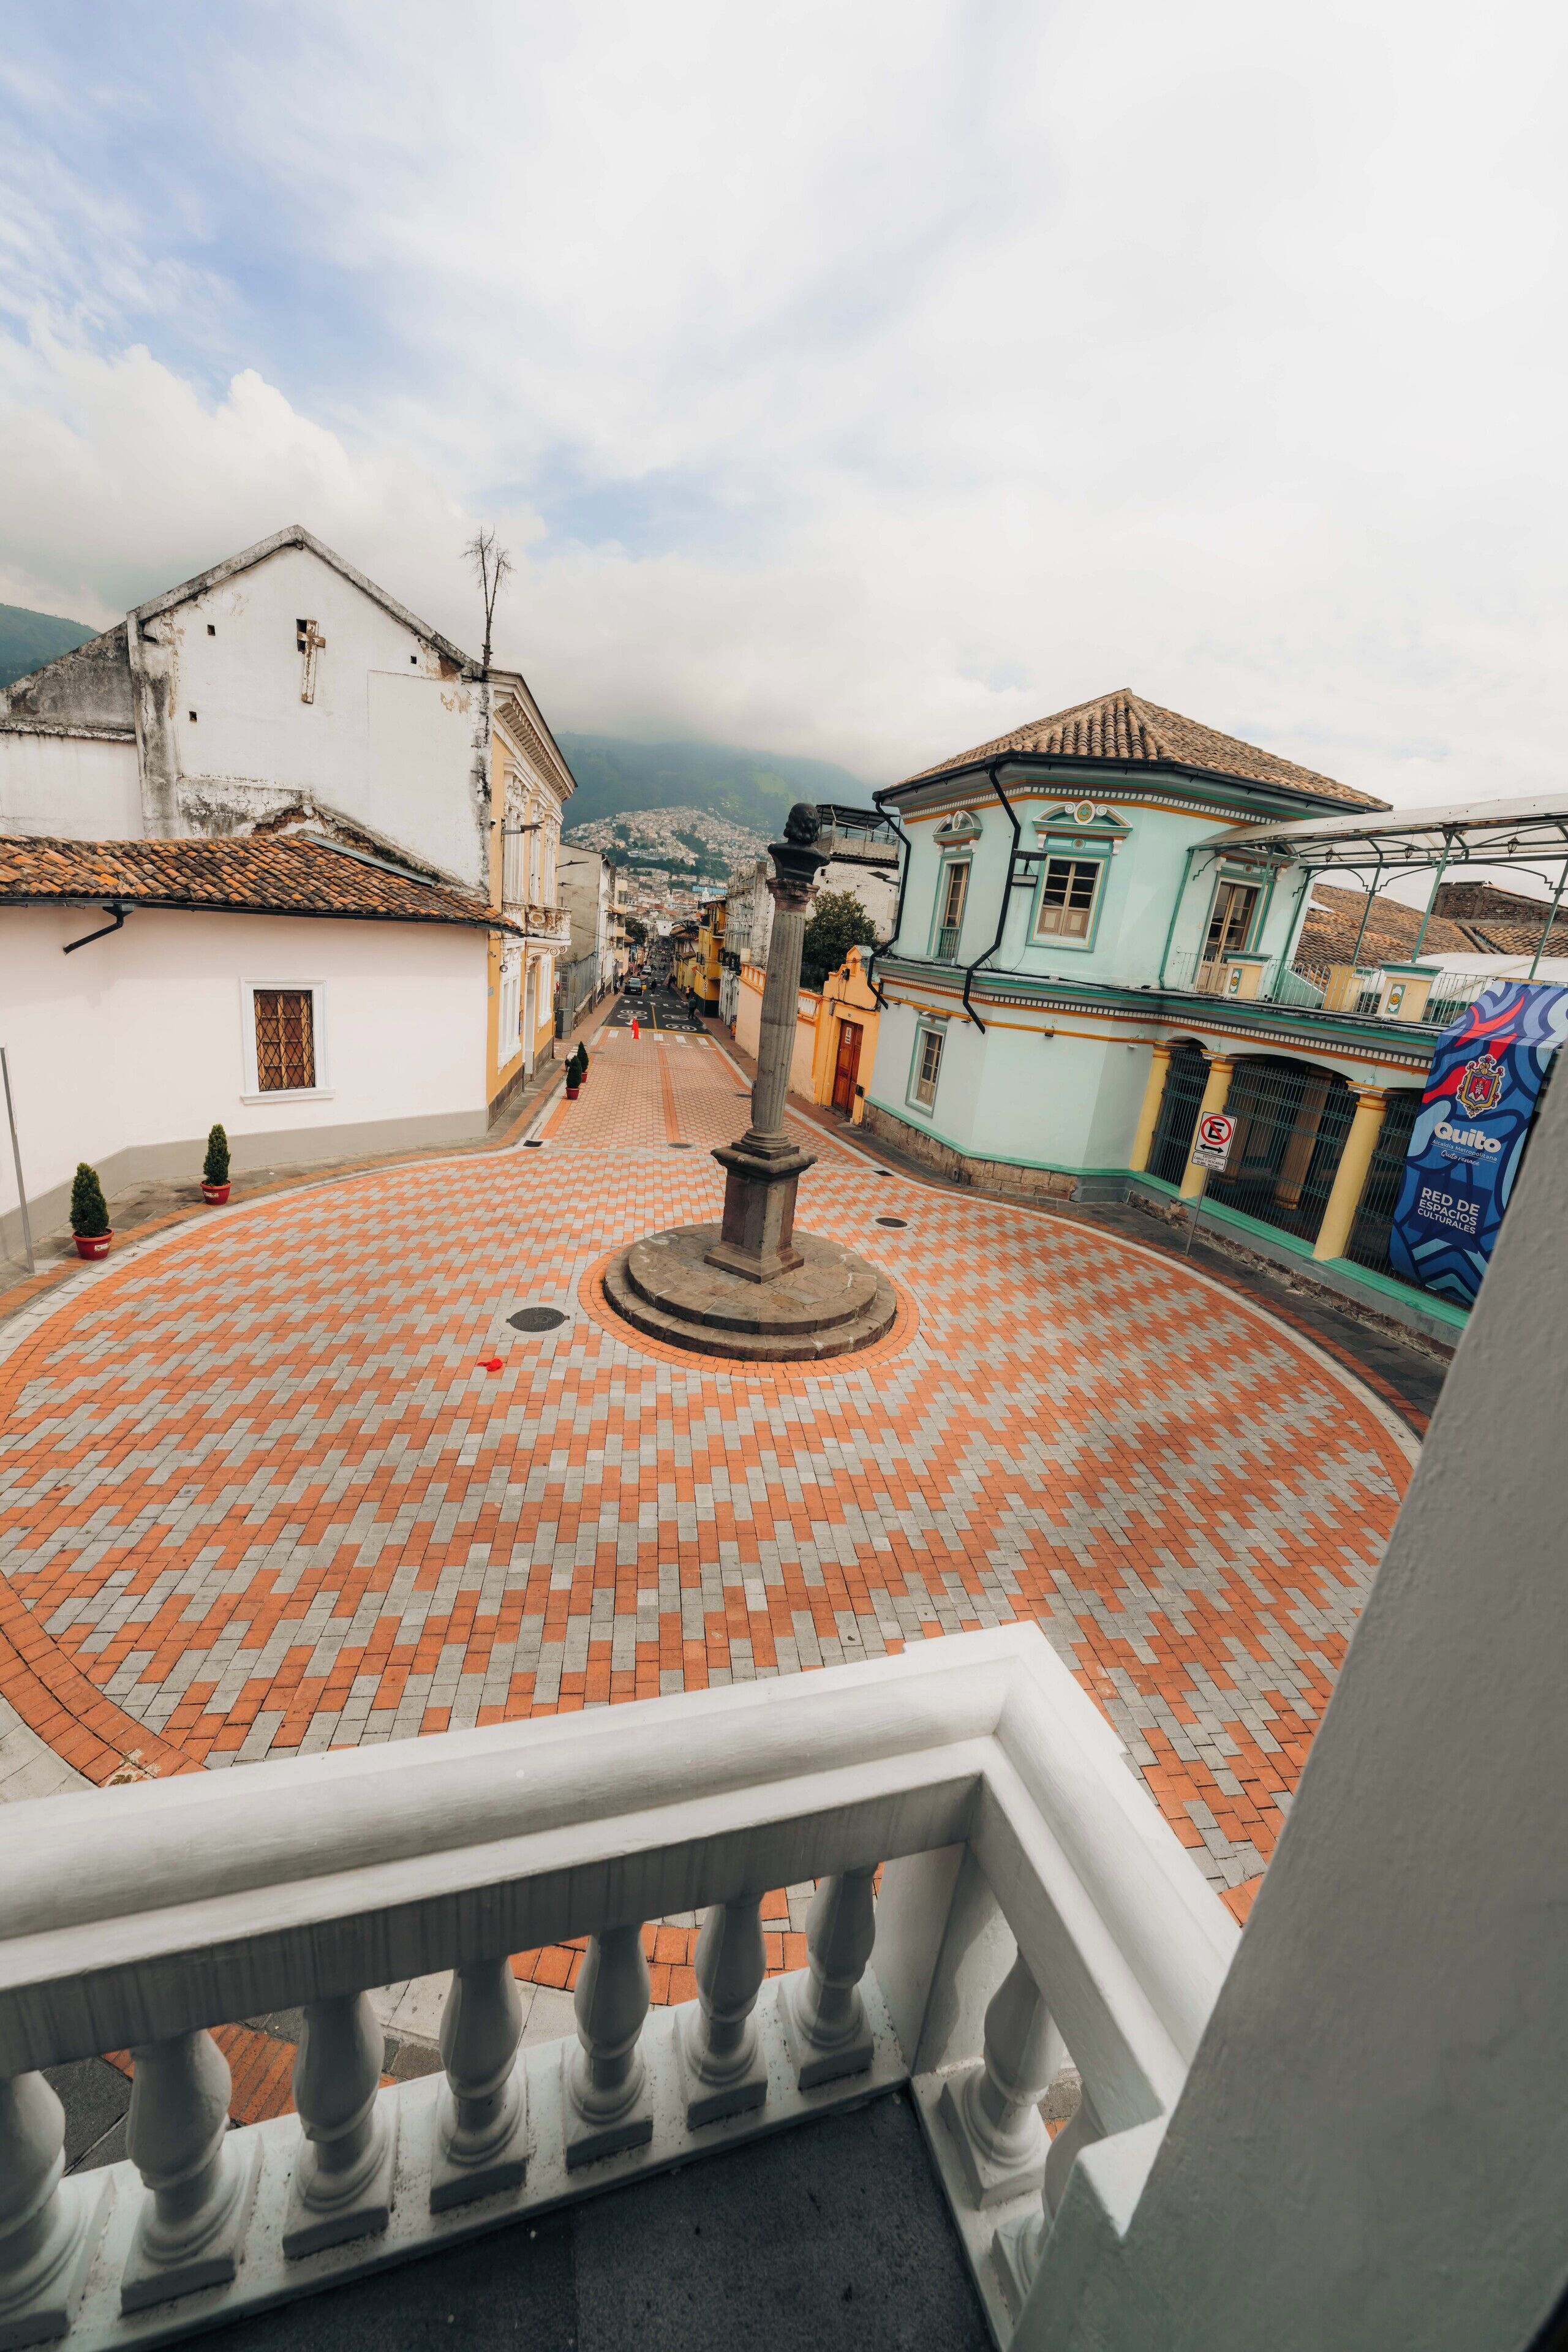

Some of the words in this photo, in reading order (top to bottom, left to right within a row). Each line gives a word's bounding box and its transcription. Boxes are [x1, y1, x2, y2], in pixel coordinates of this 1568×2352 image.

[1208, 1121, 1225, 1140] E
[1434, 1121, 1501, 1153] Quito
[1432, 1139, 1453, 1149] Alcaldía
[1455, 1146, 1498, 1161] Metropolitana
[1441, 1149, 1458, 1159] Quito
[1458, 1156, 1480, 1166] renace
[1419, 1199, 1477, 1226] ESPACIOS
[1421, 1187, 1453, 1206] RED
[1457, 1199, 1480, 1216] DE
[1417, 1208, 1476, 1234] CULTURALES
